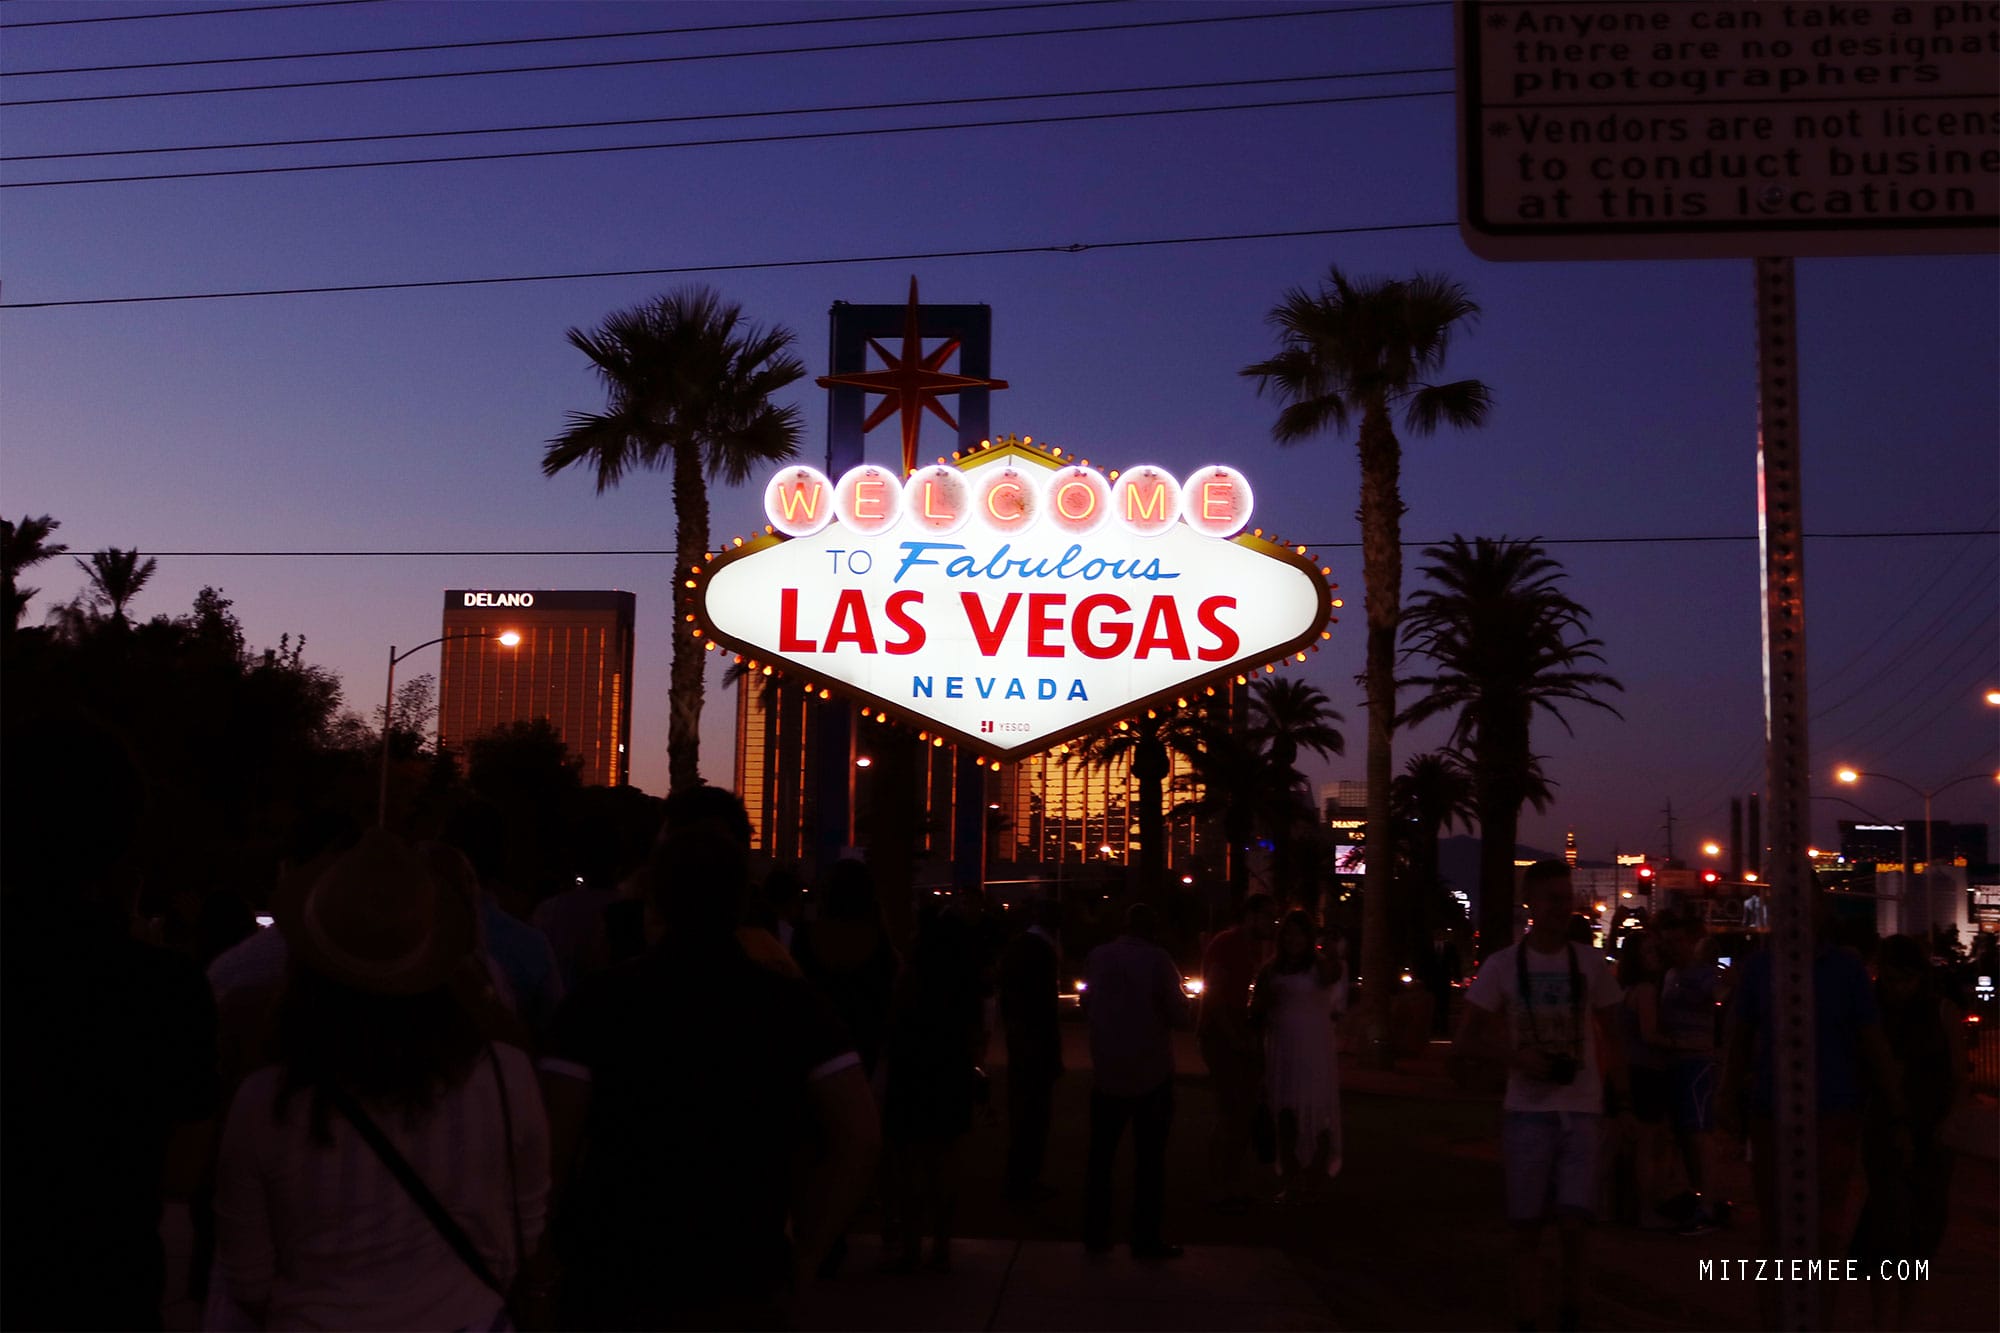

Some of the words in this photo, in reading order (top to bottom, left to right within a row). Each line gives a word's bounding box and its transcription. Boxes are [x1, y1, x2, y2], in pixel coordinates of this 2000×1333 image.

[1691, 9, 1761, 29] can
[1784, 5, 1870, 27] take
[1893, 7, 1912, 24] a
[1515, 40, 1629, 62] there
[1653, 41, 1719, 60] are
[1742, 39, 1791, 58] no
[1515, 63, 1940, 97] photographers
[1707, 115, 1772, 141] are
[1796, 109, 1860, 138] not
[1518, 152, 1566, 180] to
[1591, 148, 1800, 179] conduct
[1830, 145, 2000, 176] busine
[1518, 188, 1571, 218] at
[1599, 186, 1707, 217] this
[774, 477, 1238, 525] WELCOME
[826, 549, 872, 575] TO
[894, 541, 1181, 584] Fabulous
[463, 592, 534, 607] DELANO
[778, 587, 925, 655] LAS
[960, 591, 1241, 661] VEGAS
[913, 675, 1089, 702] NEVADA
[999, 722, 1031, 732] YESCO
